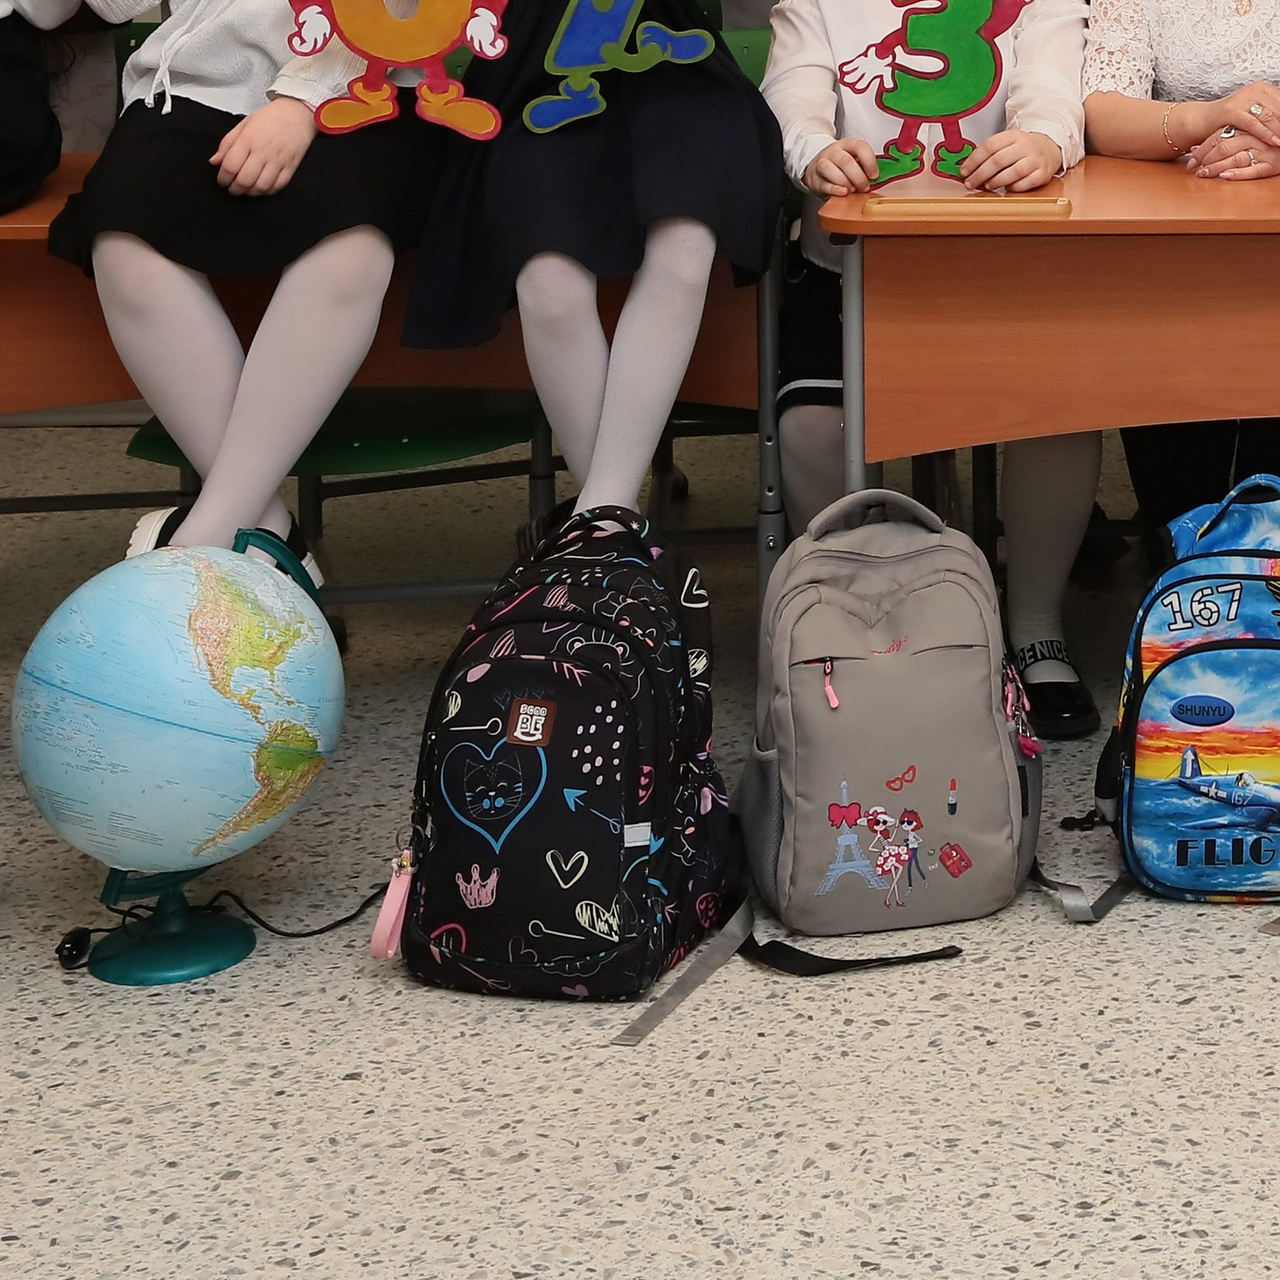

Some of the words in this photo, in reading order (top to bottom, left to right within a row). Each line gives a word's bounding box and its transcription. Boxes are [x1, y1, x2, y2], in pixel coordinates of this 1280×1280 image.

[1161, 581, 1242, 632] 167
[520, 704, 547, 716] SCOO
[1178, 704, 1226, 716] SHUNYU
[1231, 789, 1255, 806] 167
